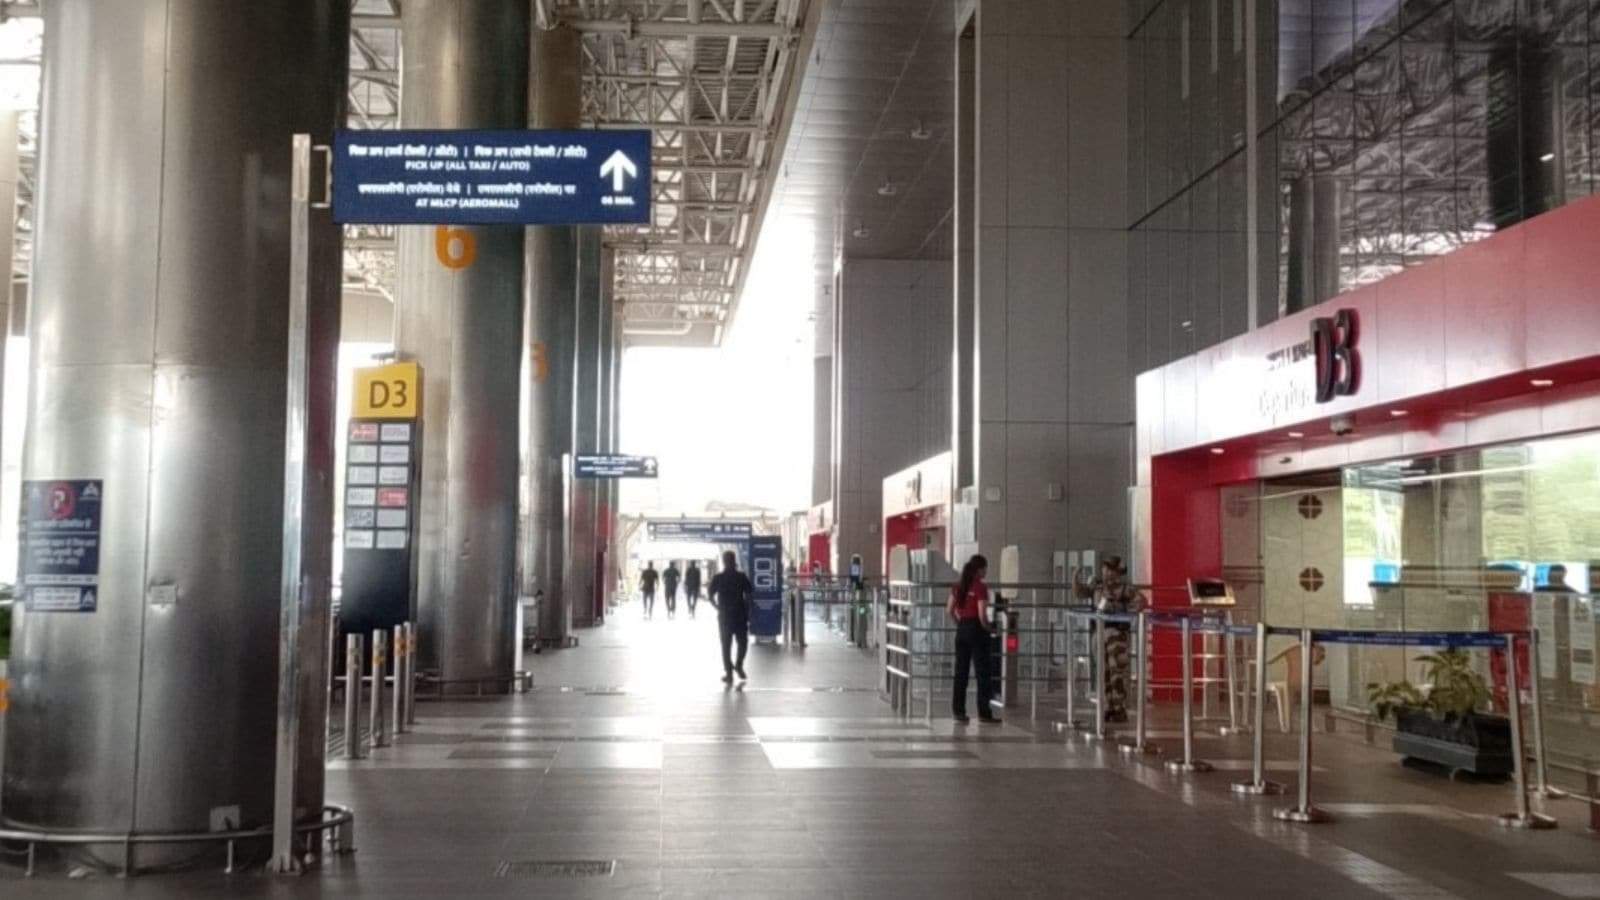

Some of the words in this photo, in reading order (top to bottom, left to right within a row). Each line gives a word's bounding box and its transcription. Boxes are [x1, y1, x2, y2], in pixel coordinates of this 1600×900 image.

[405, 160, 428, 170] PICK
[430, 160, 445, 170] UP
[445, 160, 467, 172] (ALL
[468, 161, 490, 170] TAXI
[499, 161, 531, 171] AUTO)
[415, 198, 429, 207] AT
[430, 198, 458, 207] MLCP
[458, 198, 520, 209] (AEROMALL)
[1310, 308, 1362, 404] D3
[369, 379, 408, 409] D3
